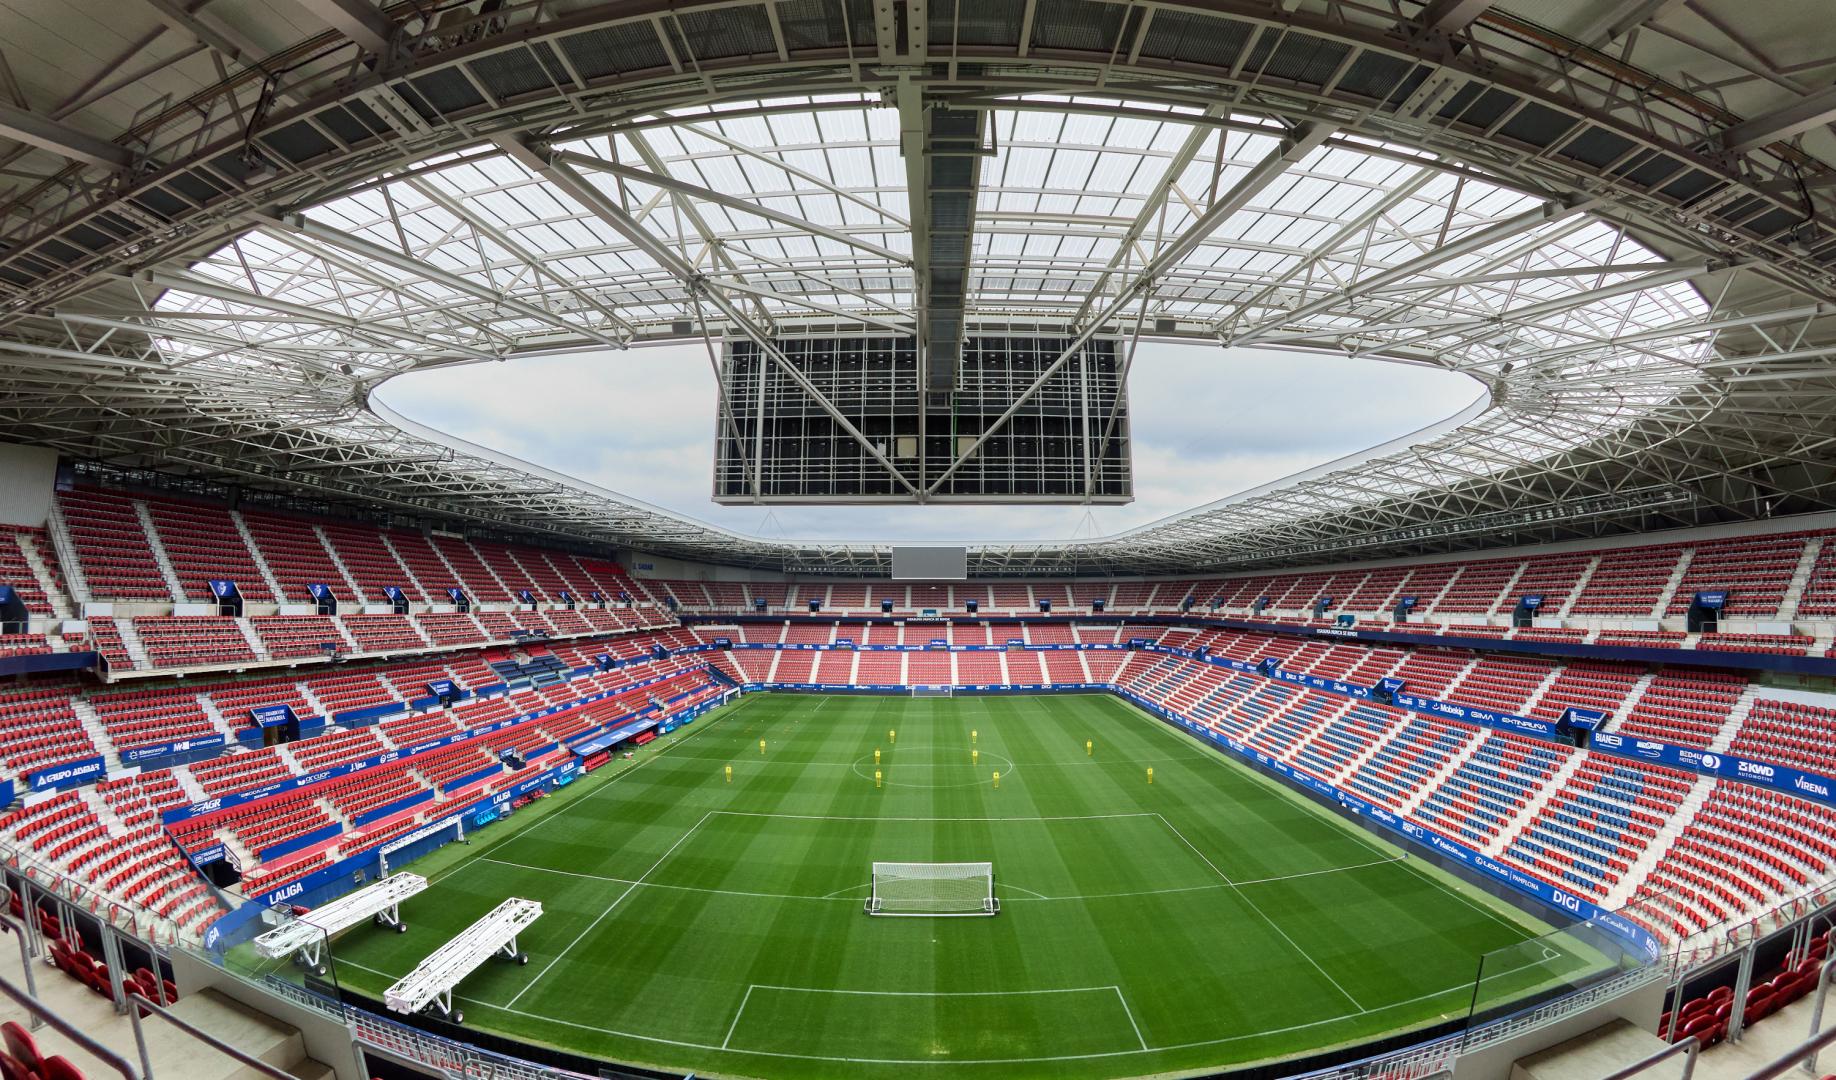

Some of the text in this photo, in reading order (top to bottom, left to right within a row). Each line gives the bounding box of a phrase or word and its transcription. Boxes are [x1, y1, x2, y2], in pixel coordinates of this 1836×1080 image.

[1794, 776, 1829, 796] VIRENA
[269, 882, 304, 906] LALIGA
[1552, 890, 1580, 912] DIGI
